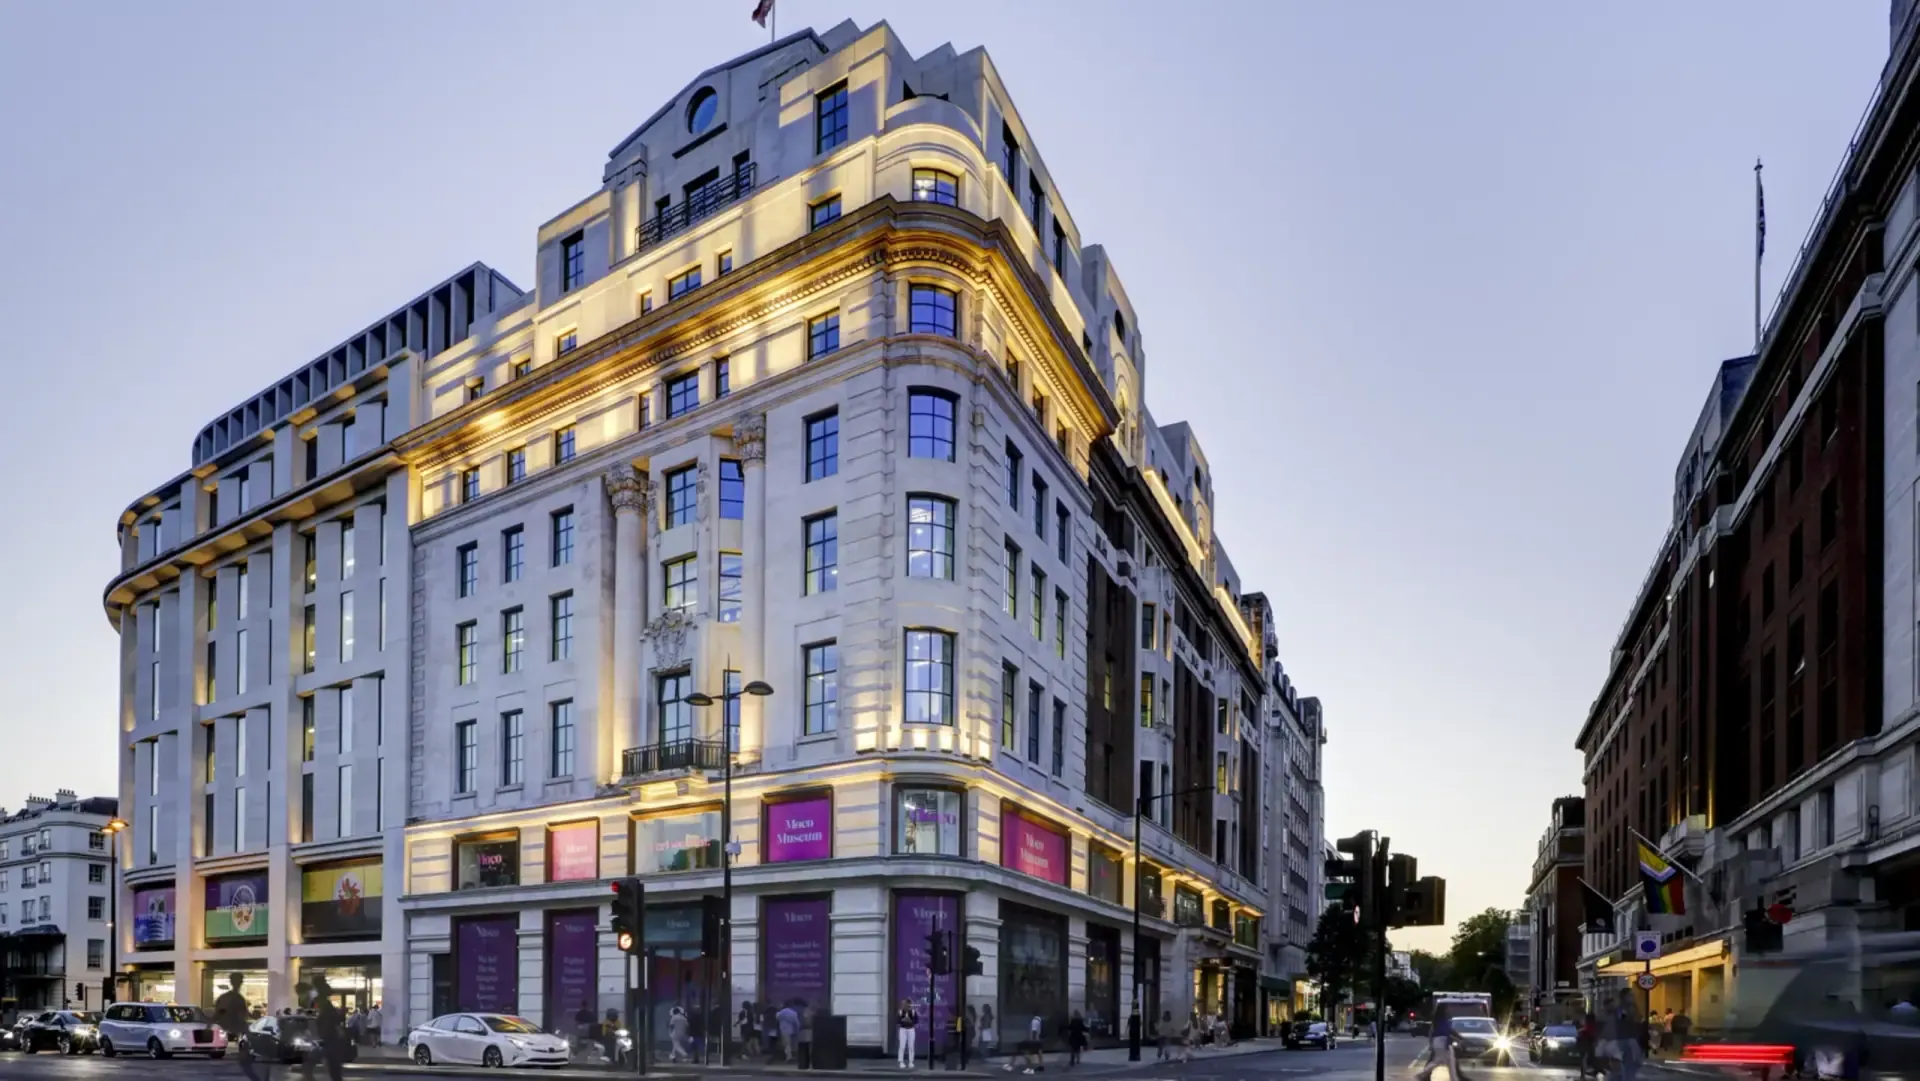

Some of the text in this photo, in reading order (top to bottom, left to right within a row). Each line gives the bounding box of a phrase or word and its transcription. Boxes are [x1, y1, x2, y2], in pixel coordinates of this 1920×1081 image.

[784, 819, 814, 830] Moco
[776, 831, 823, 845] Museum
[1641, 977, 1654, 985] 20
